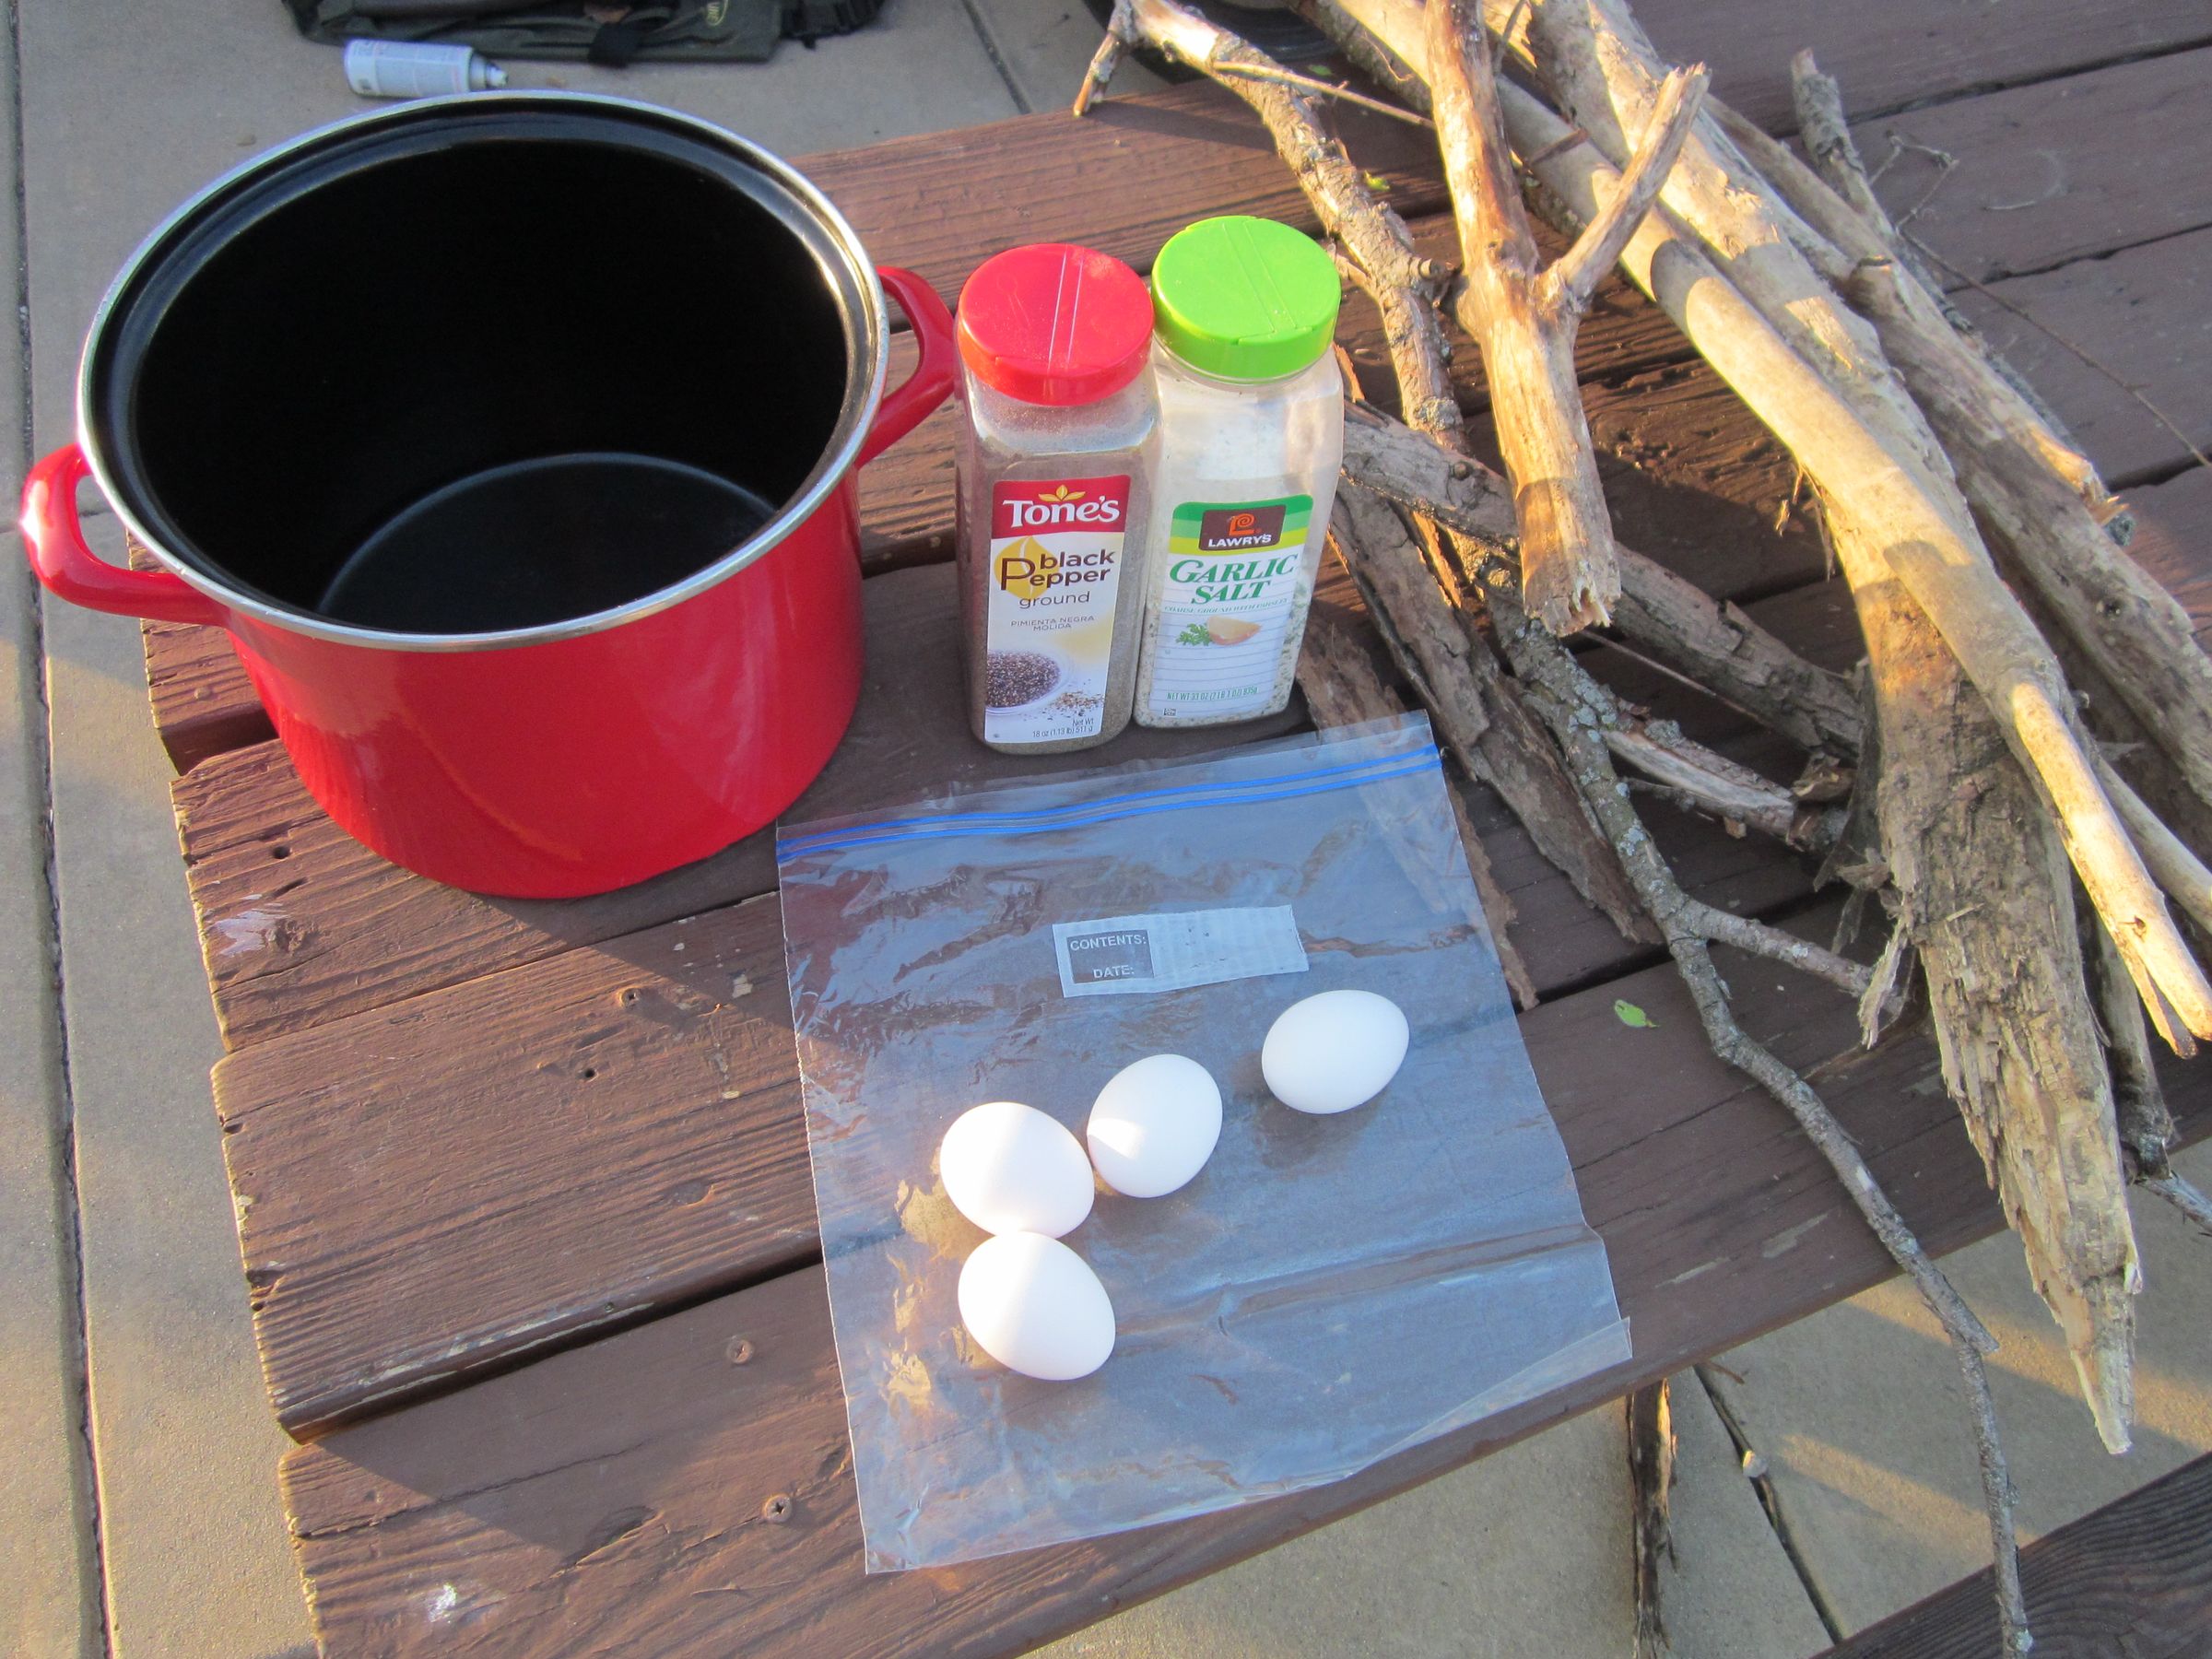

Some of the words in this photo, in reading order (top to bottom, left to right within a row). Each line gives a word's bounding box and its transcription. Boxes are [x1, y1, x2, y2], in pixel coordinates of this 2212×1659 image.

[1002, 495, 1121, 528] Tone's
[1208, 534, 1272, 547] LAWRY'S
[1040, 548, 1115, 570] black
[1001, 558, 1112, 591] Pepper
[1170, 553, 1299, 583] GARLIC
[1019, 591, 1090, 609] ground
[1191, 581, 1271, 605] SALT
[1010, 618, 1056, 628] PIMIENTA
[1059, 615, 1095, 624] NEGRA
[1033, 623, 1073, 632] MOLIDA
[1072, 718, 1084, 726] Net
[1069, 934, 1147, 951] CONTENTS:
[1092, 964, 1135, 979] DATE:
